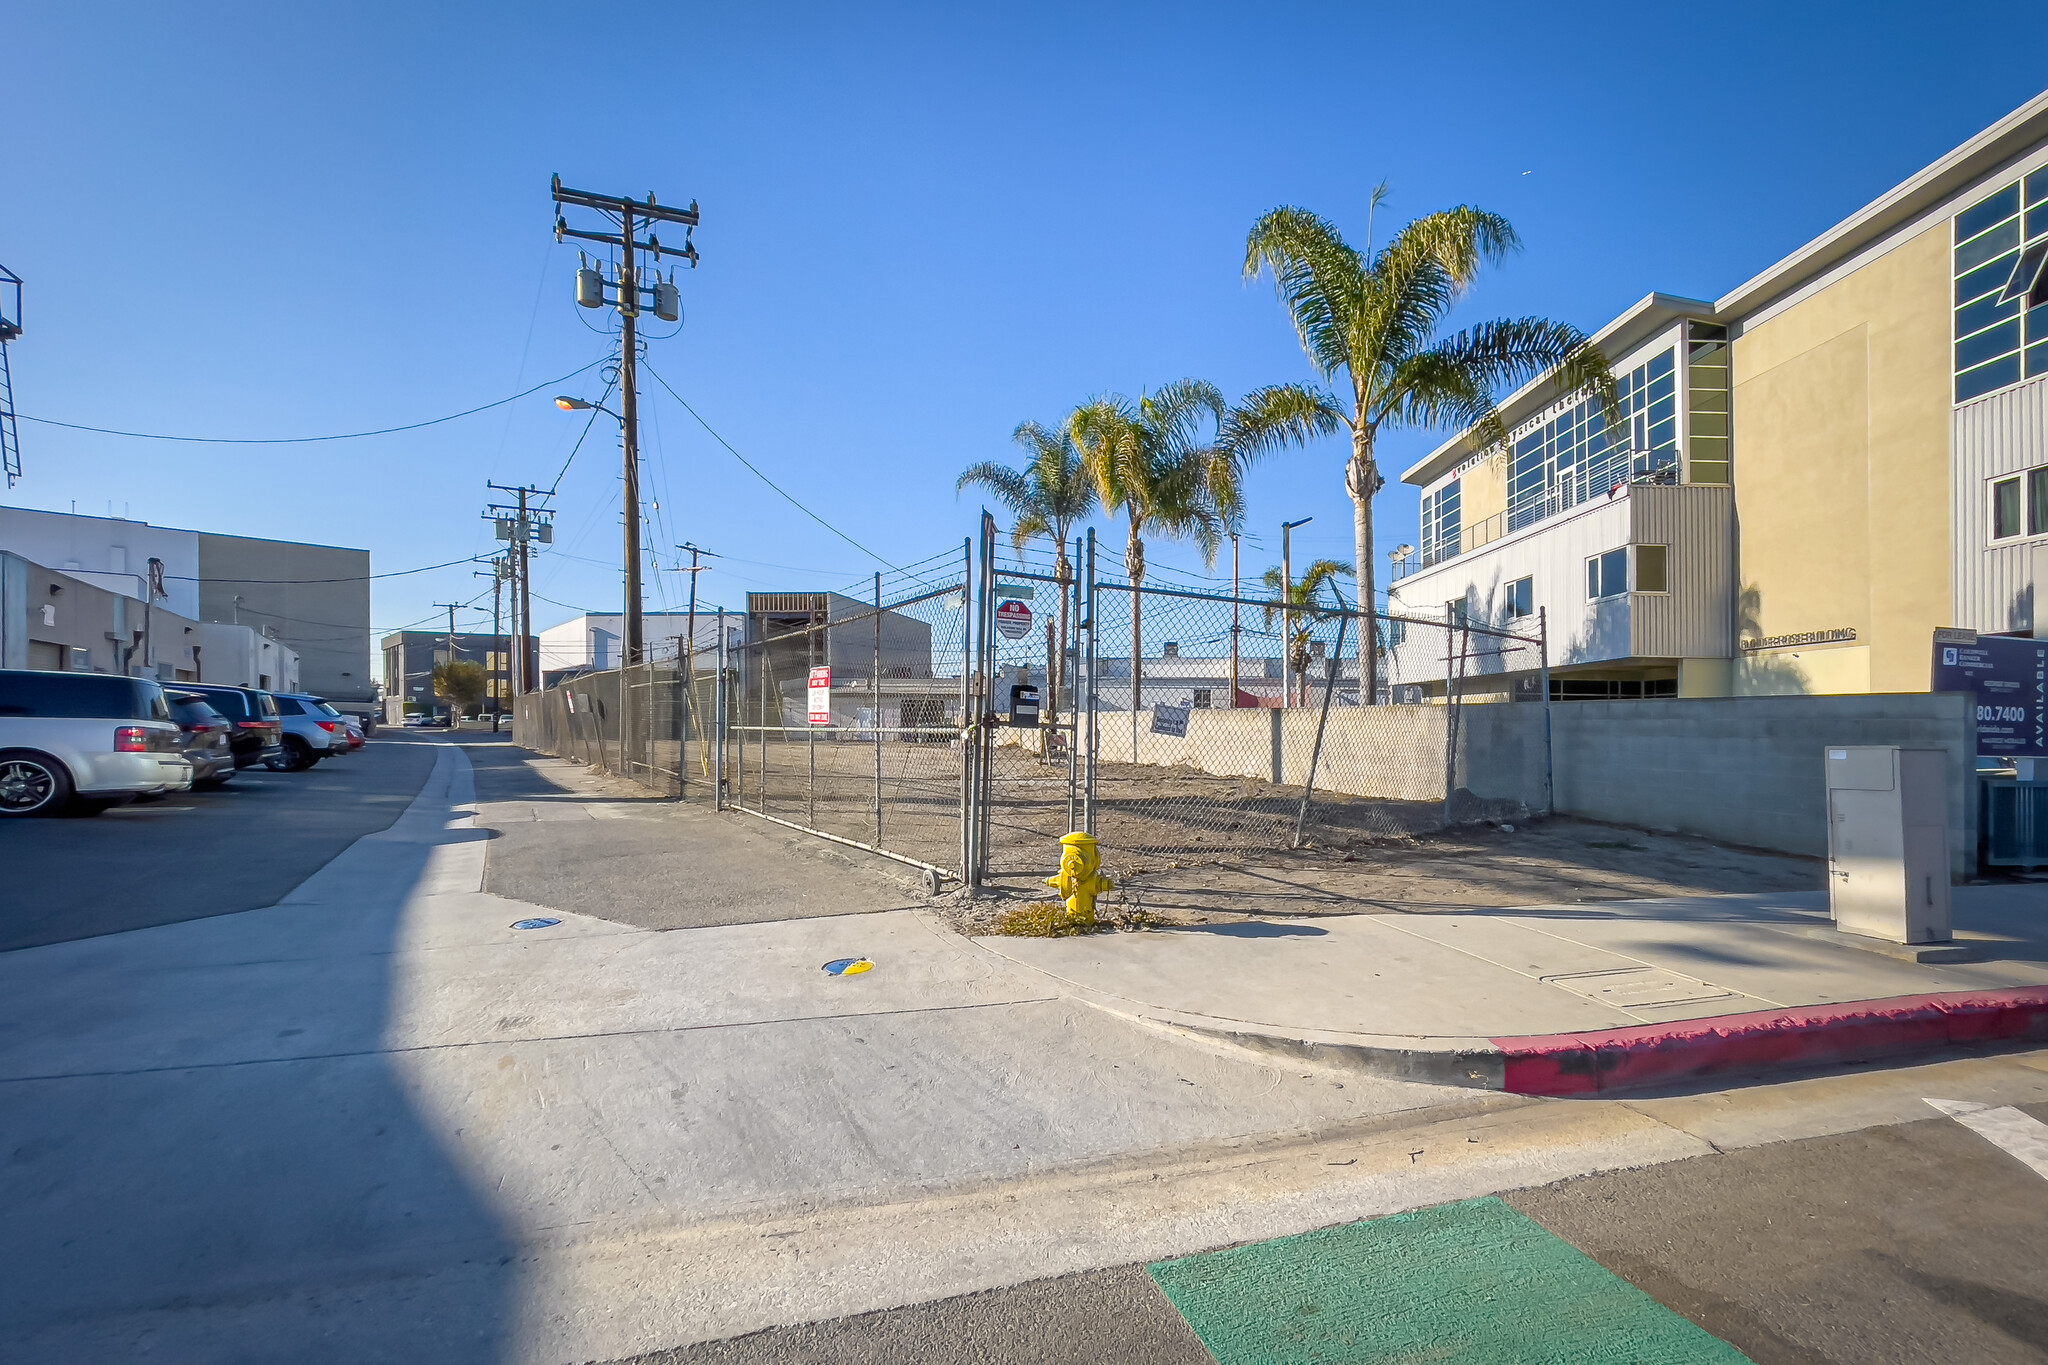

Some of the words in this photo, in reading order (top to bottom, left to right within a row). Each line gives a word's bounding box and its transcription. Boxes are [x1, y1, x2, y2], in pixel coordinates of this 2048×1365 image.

[998, 611, 1030, 619] TRESPASSING
[1954, 631, 1975, 640] LEASE
[2035, 649, 2046, 748] AVAILABLE
